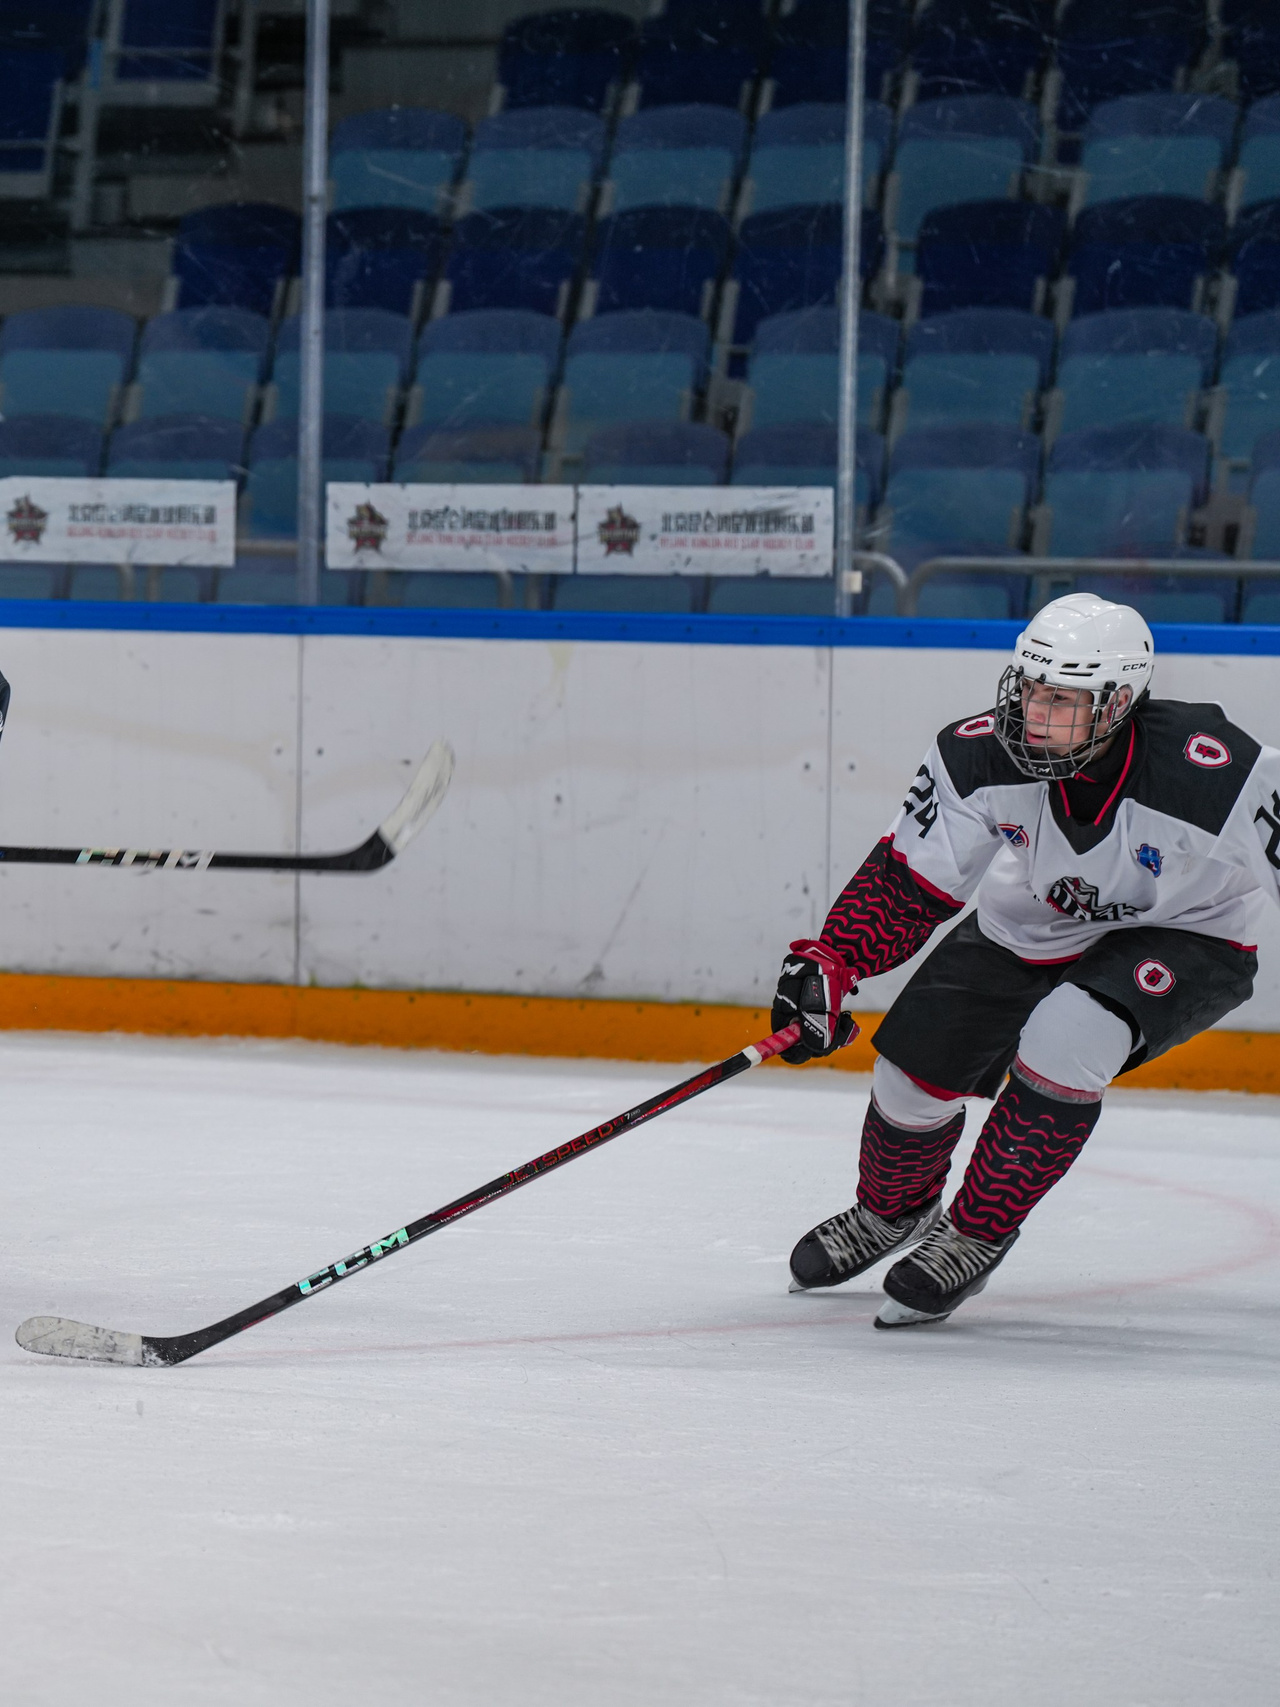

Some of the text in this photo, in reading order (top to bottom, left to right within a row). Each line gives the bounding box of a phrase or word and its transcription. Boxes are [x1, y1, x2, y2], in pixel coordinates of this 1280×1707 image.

[1022, 650, 1053, 665] CCM
[1122, 662, 1147, 672] CCM
[803, 1021, 823, 1037] CCM
[504, 1121, 614, 1188] JETSPEED
[297, 1228, 410, 1296] CCM
